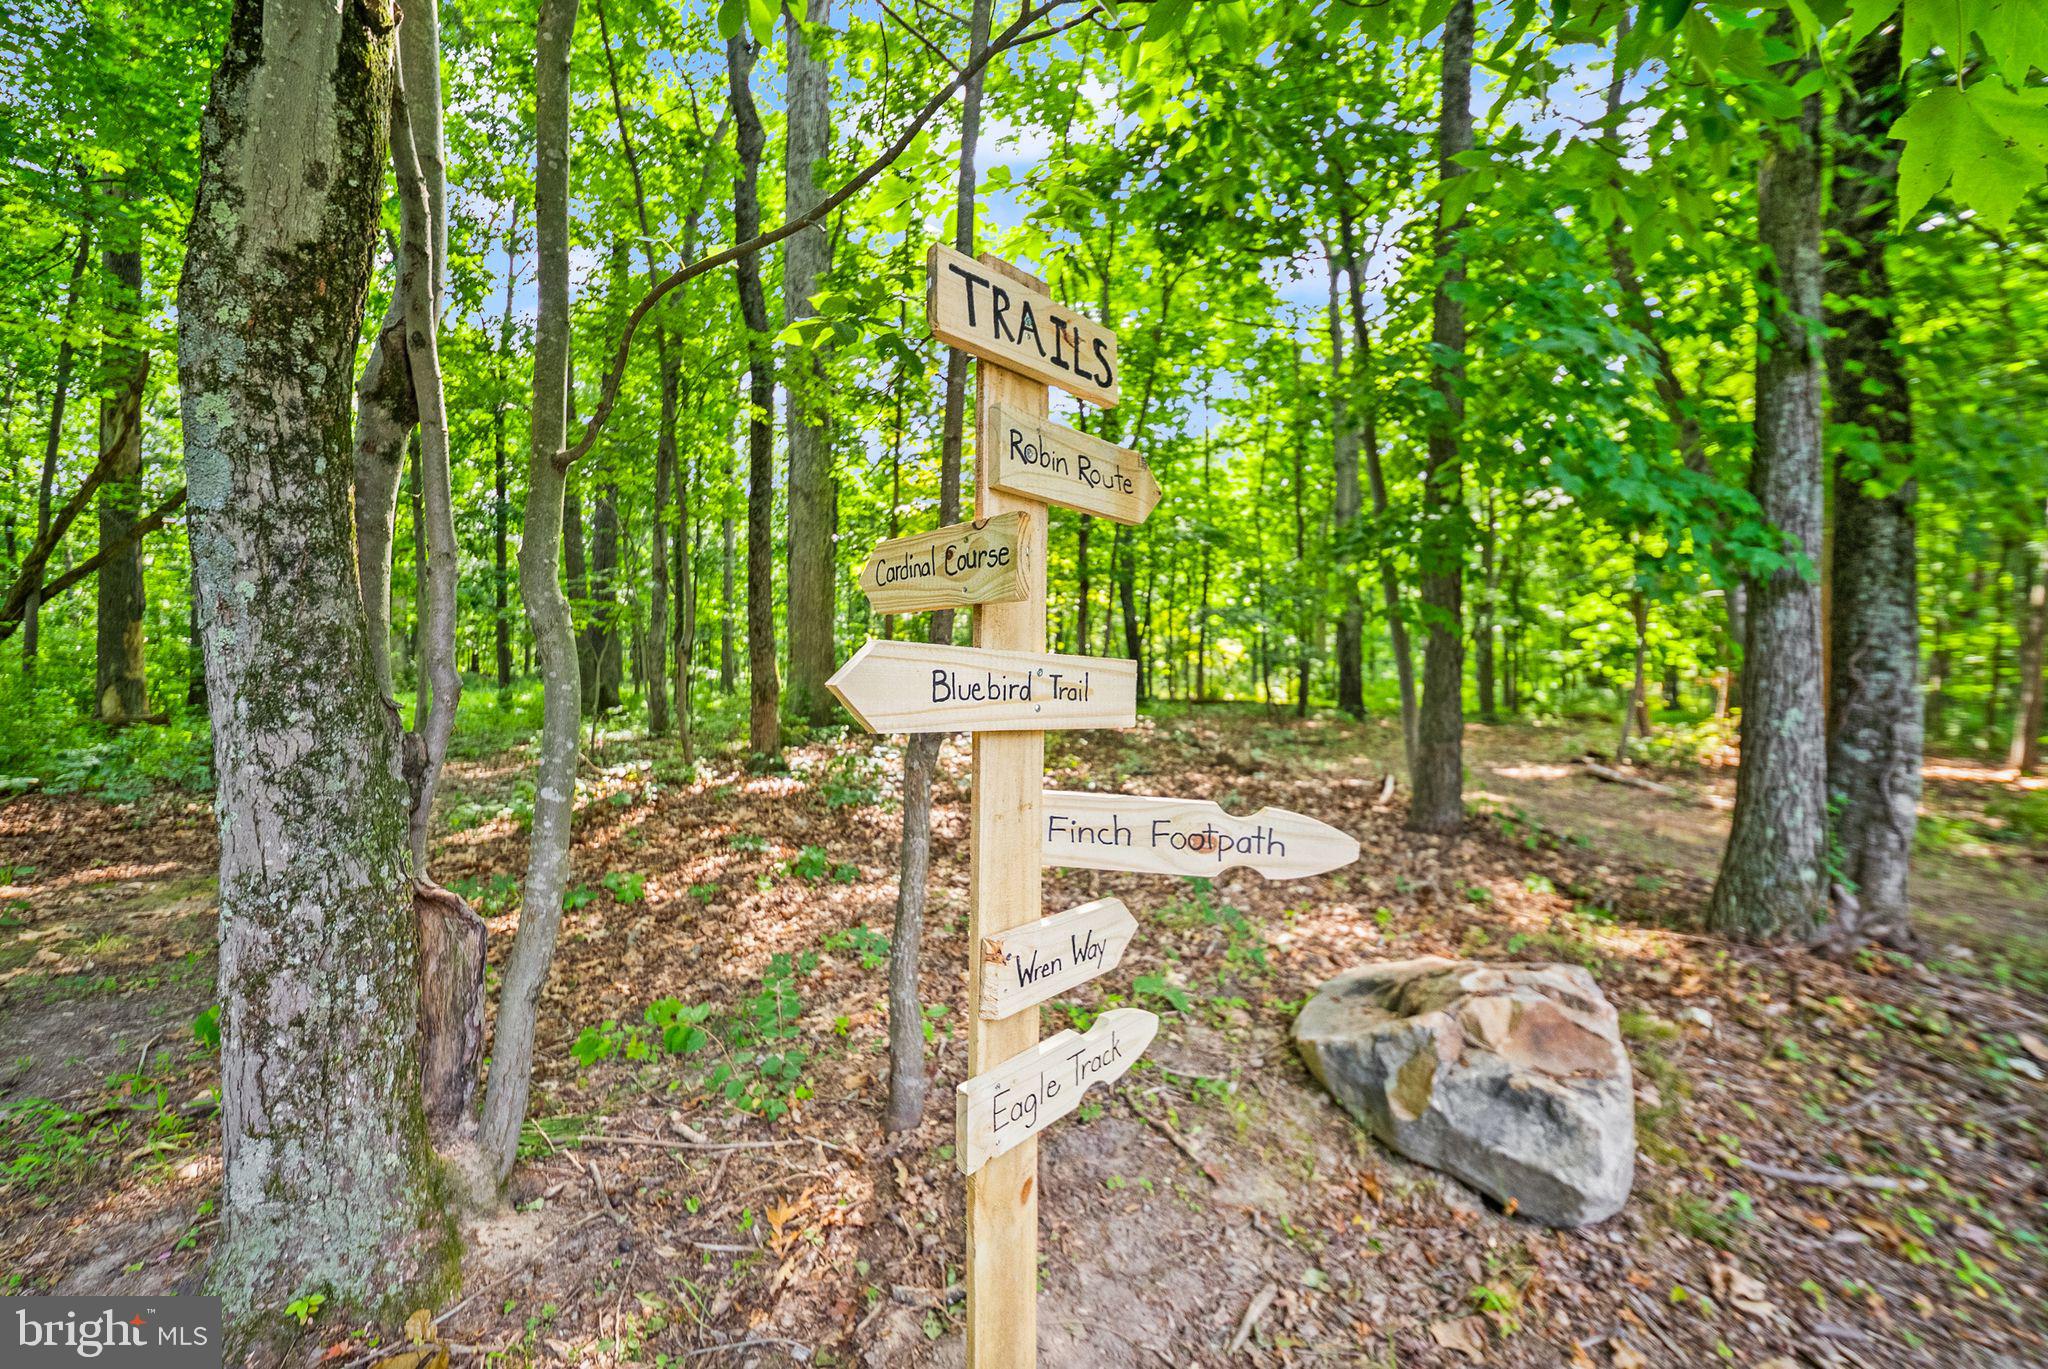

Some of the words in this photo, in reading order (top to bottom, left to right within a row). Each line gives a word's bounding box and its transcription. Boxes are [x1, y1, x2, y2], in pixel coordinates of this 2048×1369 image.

[949, 263, 1113, 389] TRAILS
[1009, 428, 1069, 475] Robin
[1077, 455, 1134, 495] Route
[875, 545, 936, 587] Cardinal
[944, 545, 1010, 577] Course
[931, 669, 1032, 703] Bluebird
[1049, 672, 1089, 702] Trail
[1047, 815, 1132, 847] Finch
[1151, 820, 1286, 861] Footpath
[1015, 950, 1063, 988] Wren
[1071, 929, 1106, 969] Way
[992, 1072, 1061, 1132] Eagle
[1066, 1031, 1122, 1086] Track
